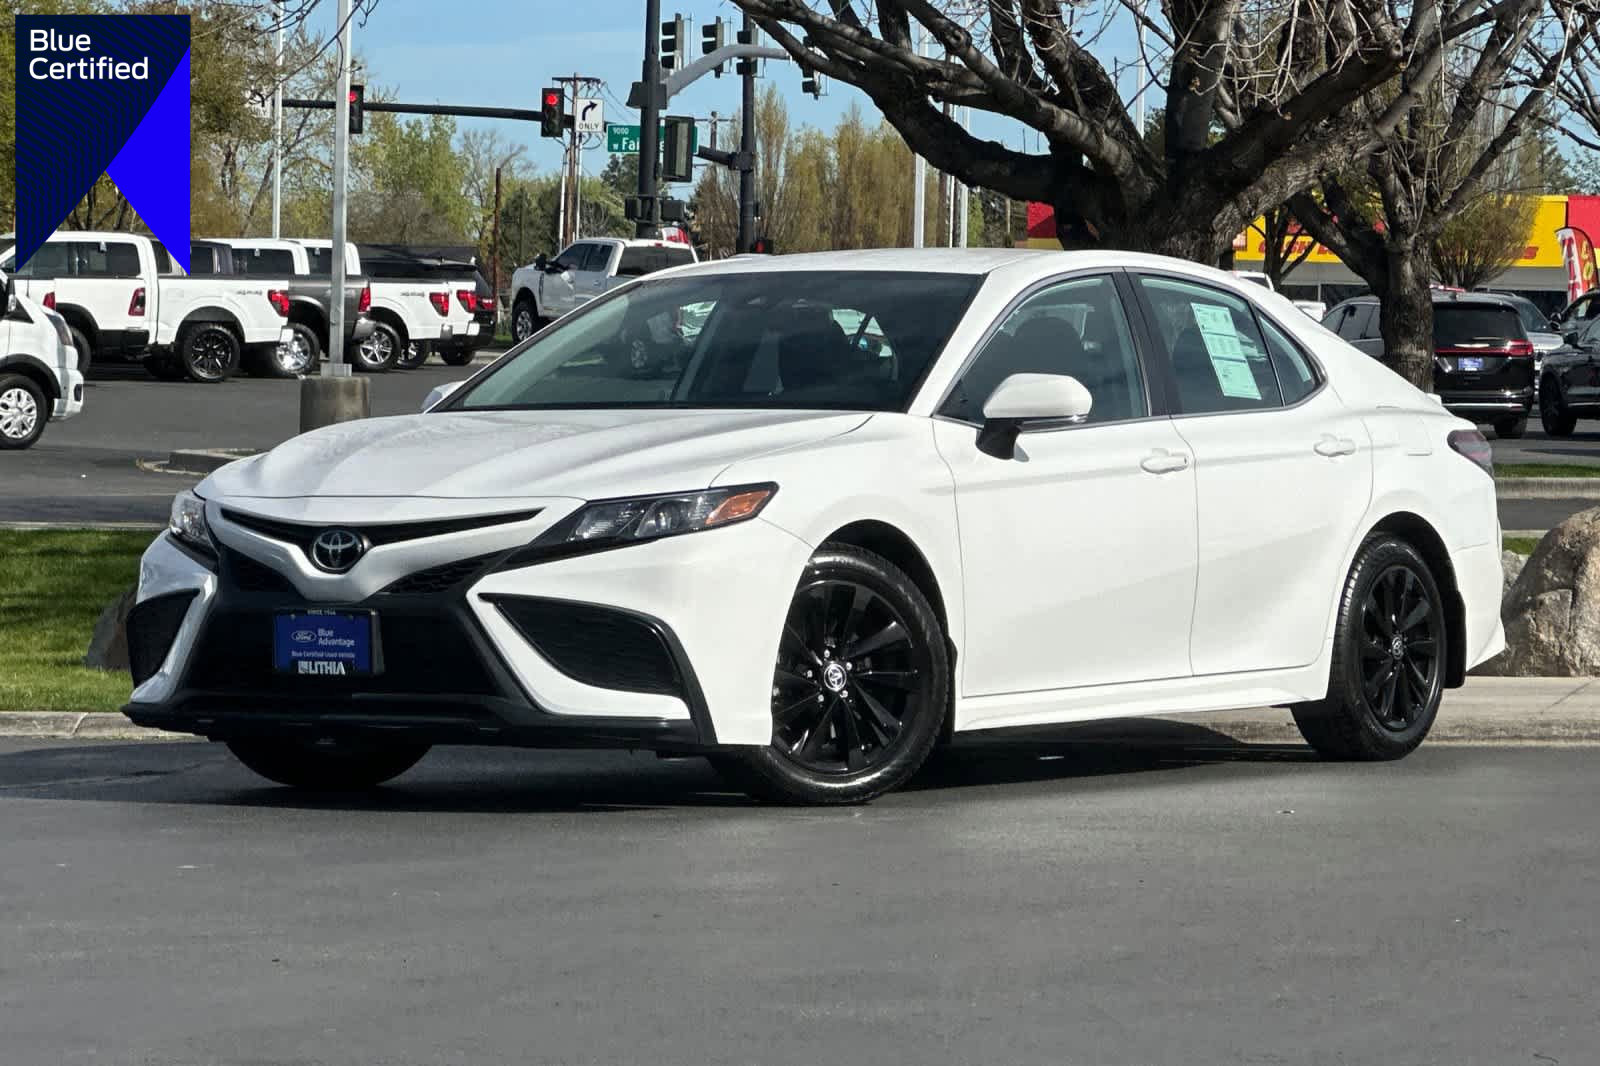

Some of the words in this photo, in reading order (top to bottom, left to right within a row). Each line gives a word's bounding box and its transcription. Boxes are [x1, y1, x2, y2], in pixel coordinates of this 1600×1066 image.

[578, 122, 600, 130] ONLY
[318, 628, 334, 637] Blue
[318, 638, 355, 647] Advantage
[309, 661, 346, 675] LITHIA
